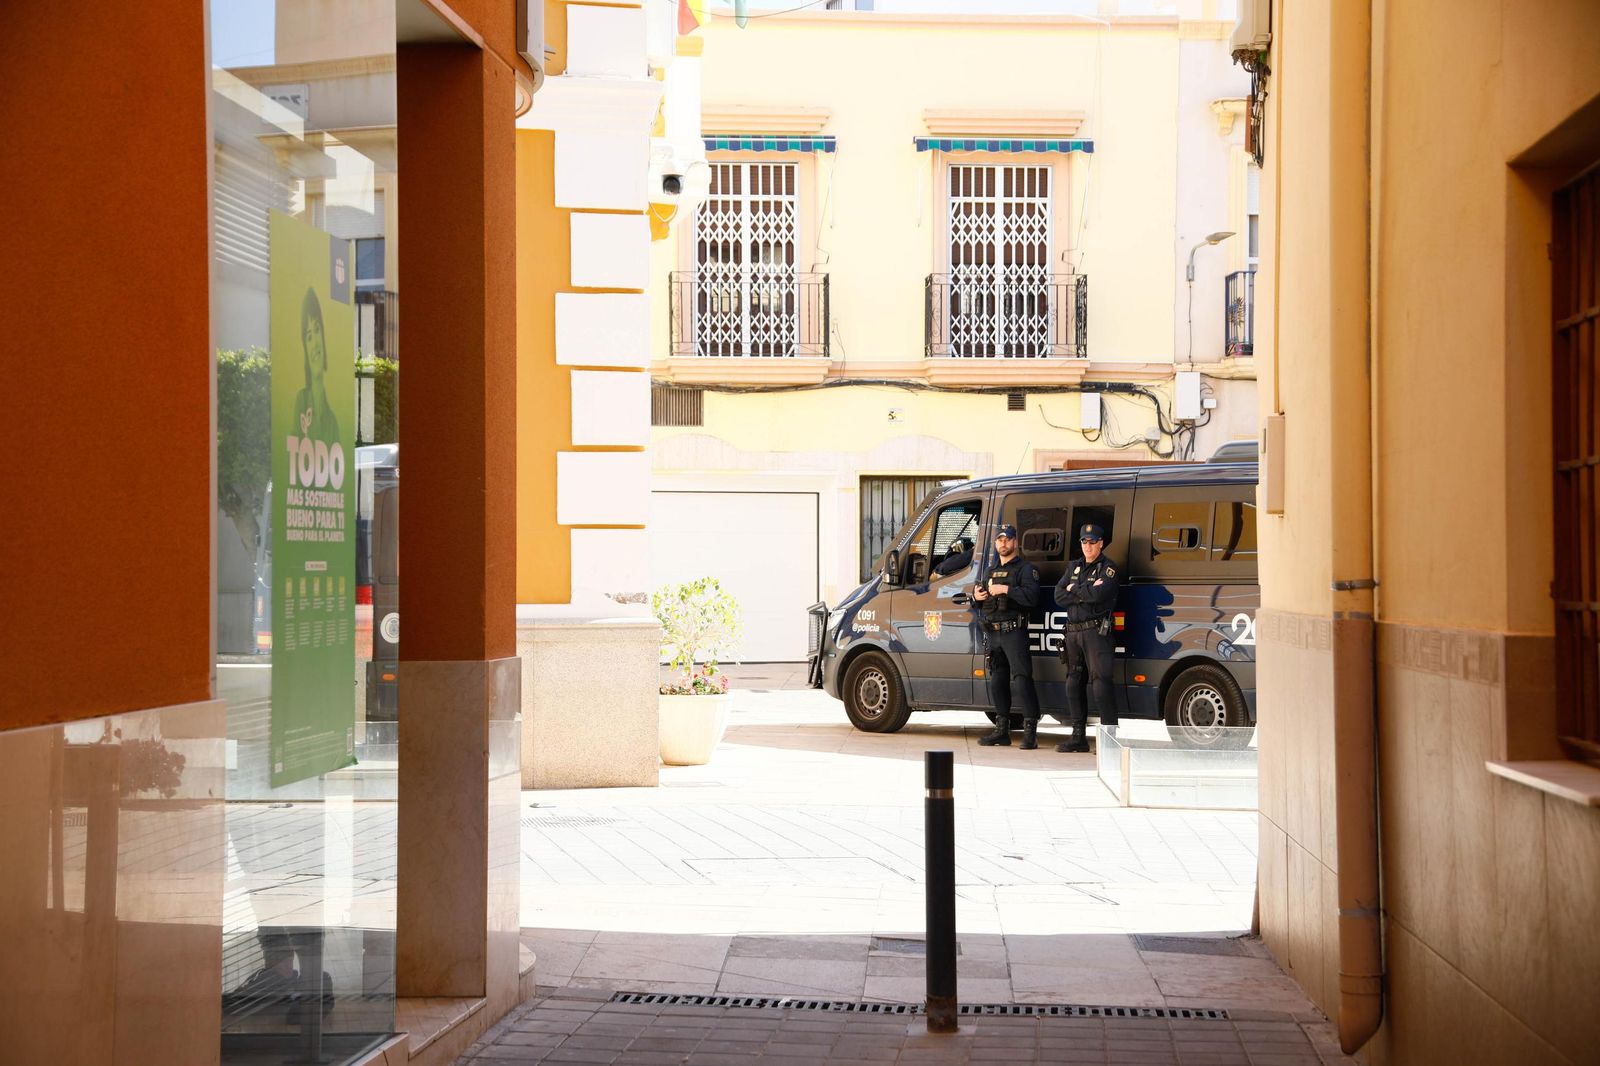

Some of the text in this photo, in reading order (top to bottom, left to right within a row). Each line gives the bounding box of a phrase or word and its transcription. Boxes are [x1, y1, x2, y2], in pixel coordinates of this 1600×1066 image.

[287, 435, 345, 490] TODO
[286, 508, 315, 529] BUENO
[316, 510, 337, 529] PARA
[1231, 612, 1257, 646] 2
